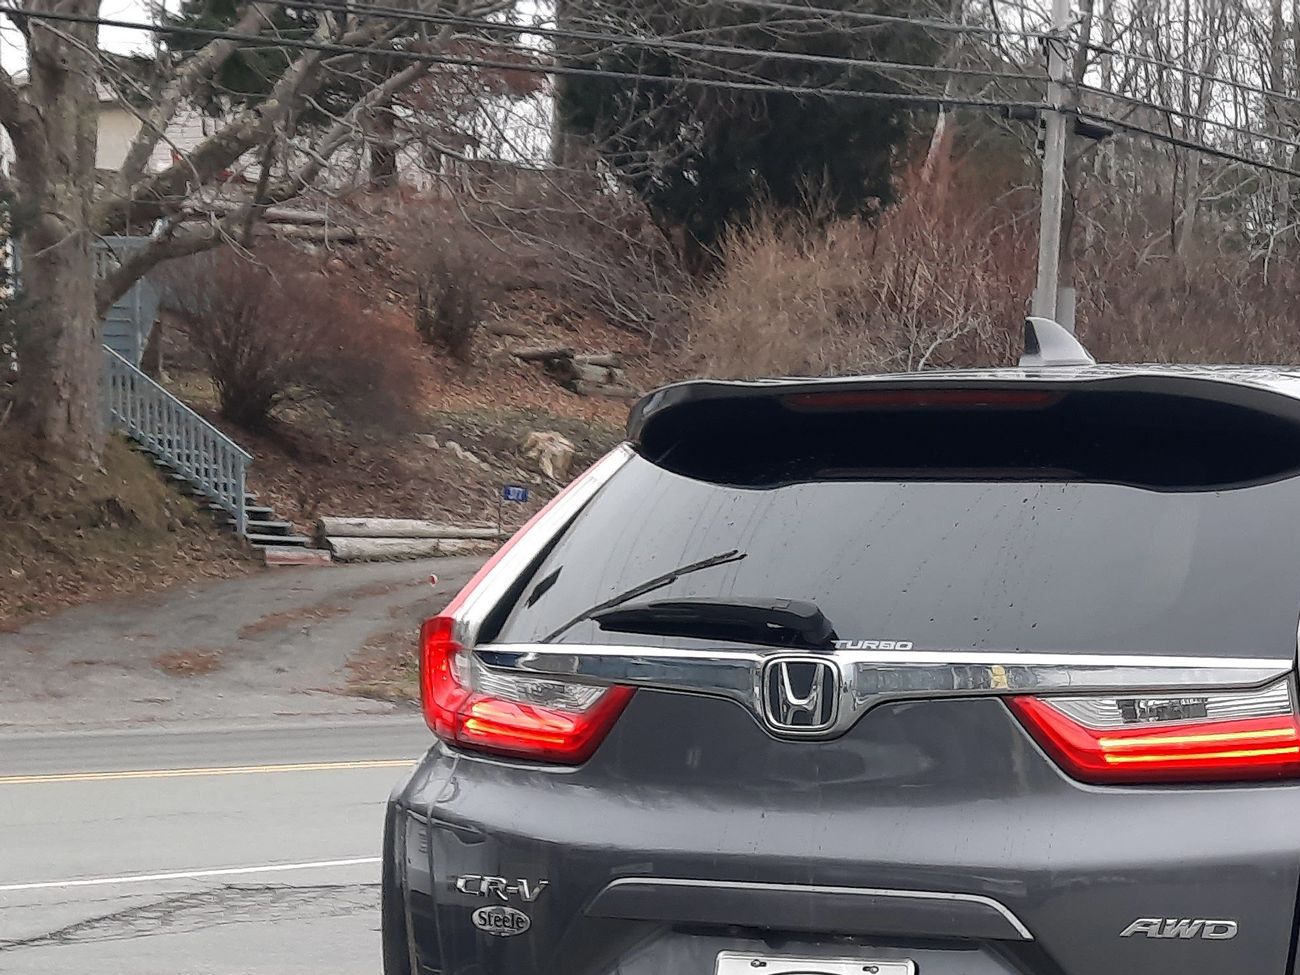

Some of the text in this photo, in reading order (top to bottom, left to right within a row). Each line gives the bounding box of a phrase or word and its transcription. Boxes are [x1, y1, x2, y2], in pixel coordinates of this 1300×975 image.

[831, 639, 914, 650] TURBO
[456, 874, 549, 902] CR-V
[478, 911, 526, 929] Steele
[1119, 917, 1239, 940] AWD
